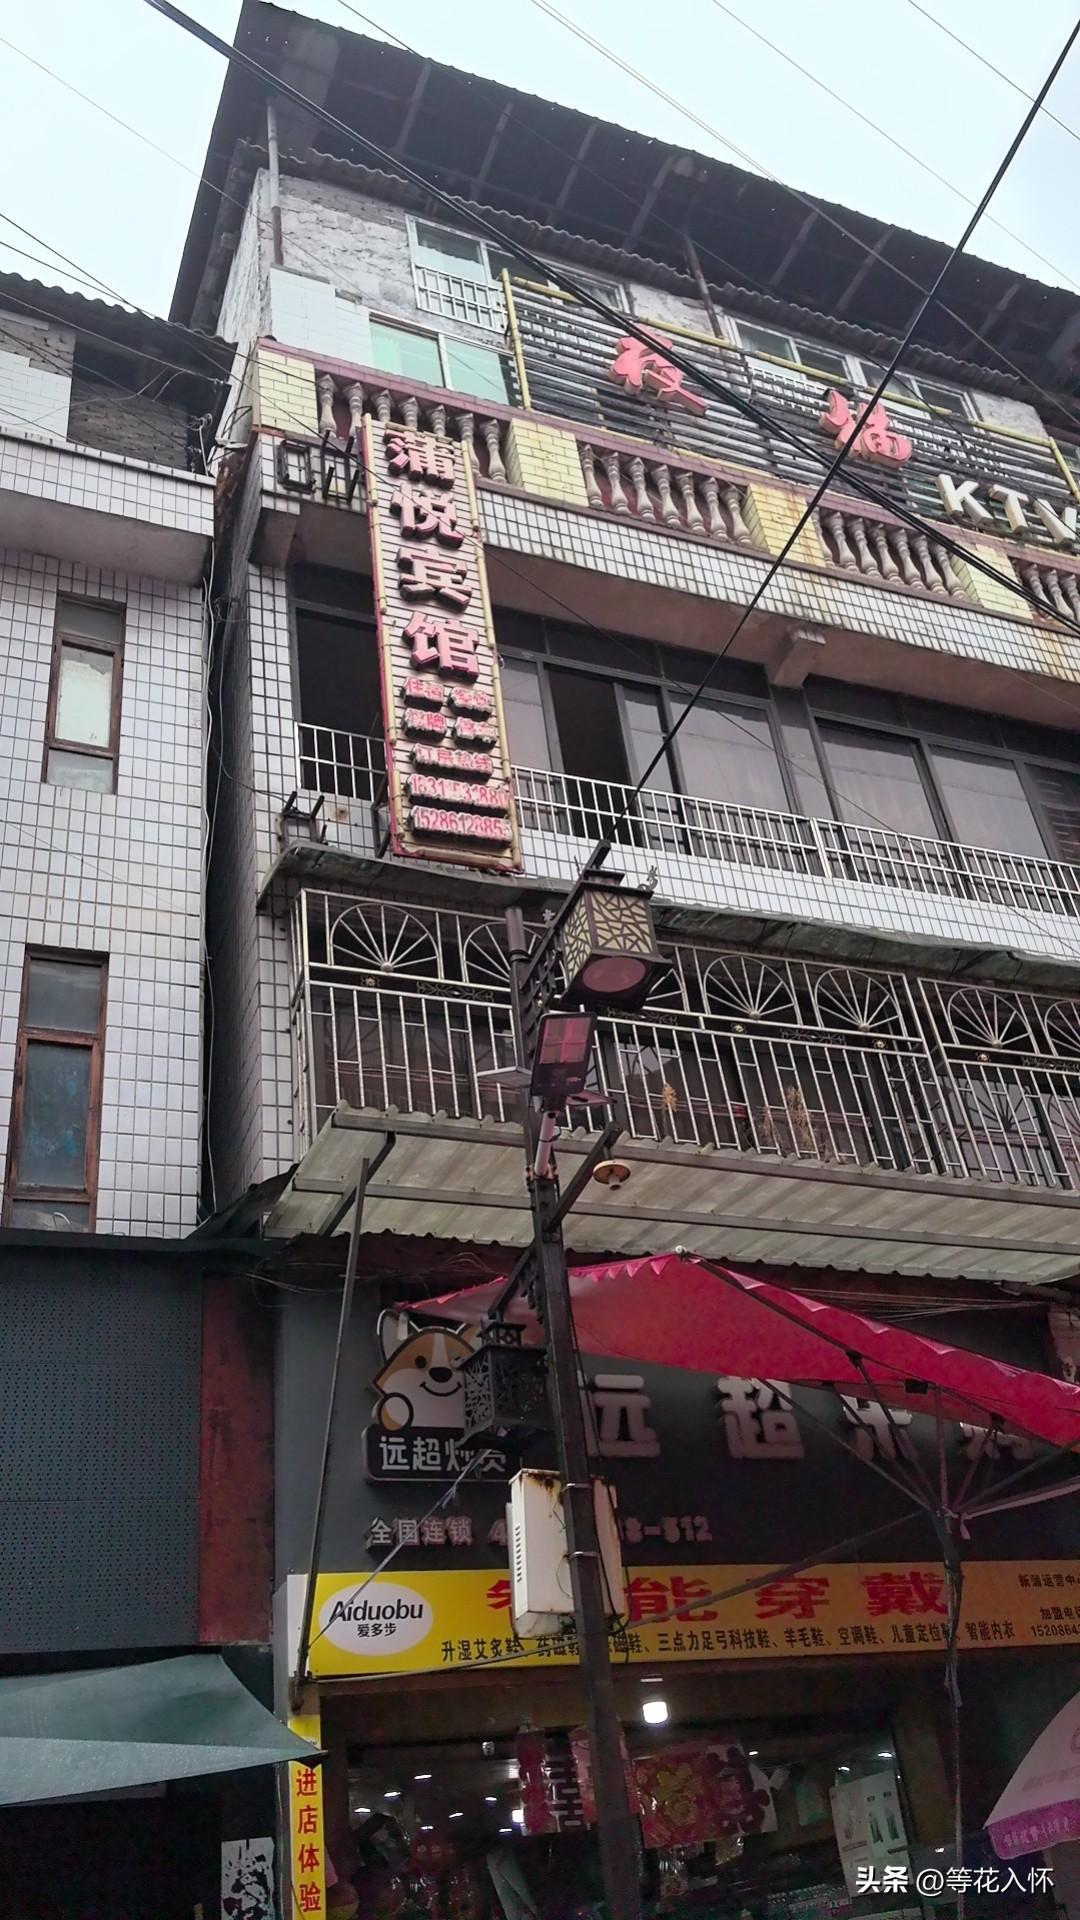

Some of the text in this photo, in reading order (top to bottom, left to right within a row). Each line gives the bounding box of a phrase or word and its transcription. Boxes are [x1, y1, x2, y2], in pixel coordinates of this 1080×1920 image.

[935, 473, 1079, 545] KTV
[385, 431, 479, 677] 蒲悦宾馆
[368, 1518, 473, 1546] 全国连锁
[329, 1599, 423, 1623] Aiduobu
[357, 1623, 396, 1638] 爱多步
[296, 1768, 321, 1912] 进店体验
